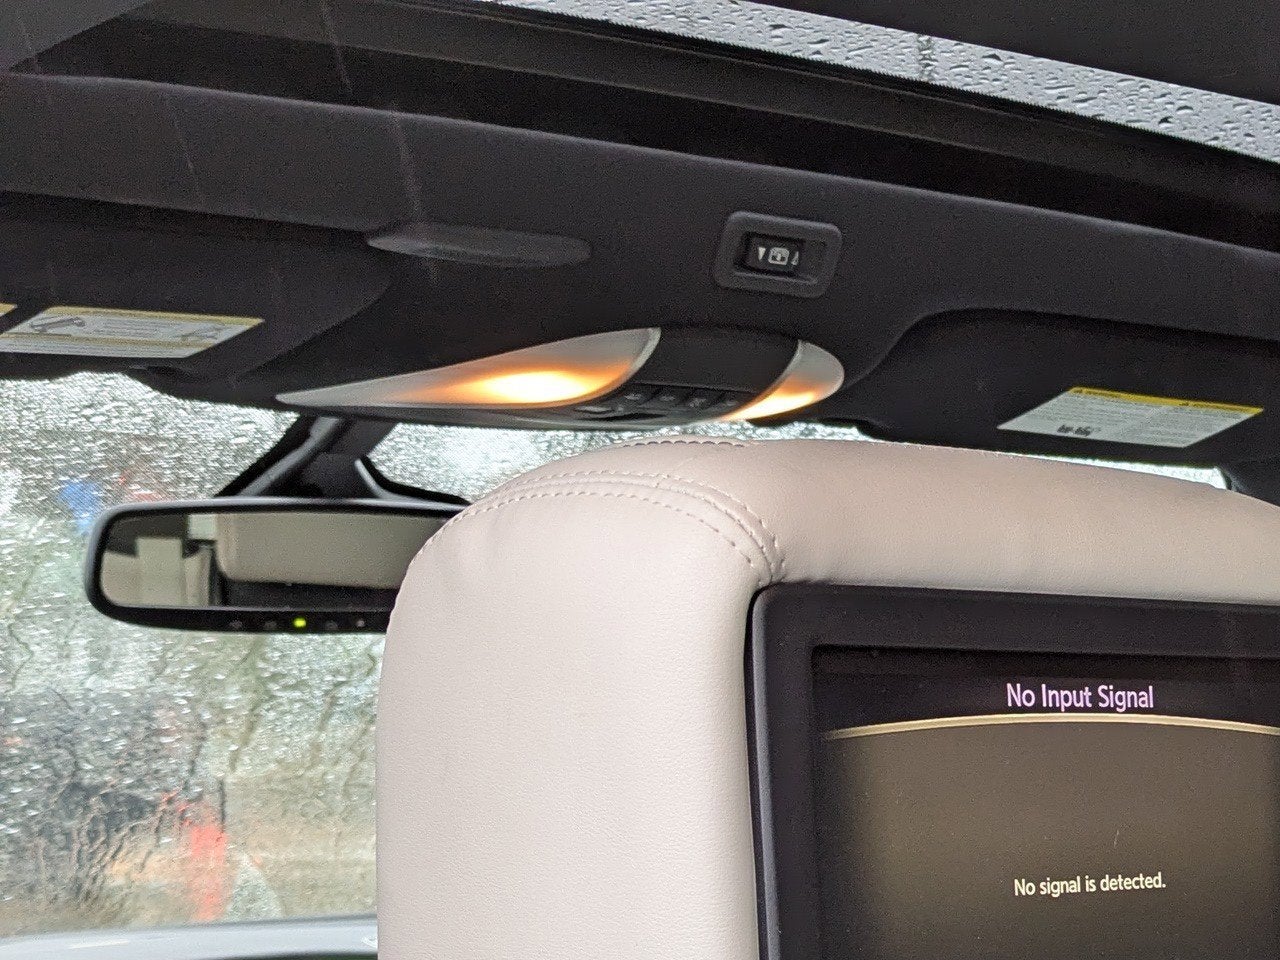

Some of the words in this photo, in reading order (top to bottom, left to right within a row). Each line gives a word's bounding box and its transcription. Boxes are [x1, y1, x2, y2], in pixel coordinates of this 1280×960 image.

[1006, 683, 1036, 707] No
[1041, 683, 1092, 712] Input
[1098, 685, 1154, 713] Signal
[1014, 878, 1036, 896] No
[1039, 876, 1081, 897] signal
[1085, 875, 1097, 892] is
[1100, 871, 1167, 892] detected.
